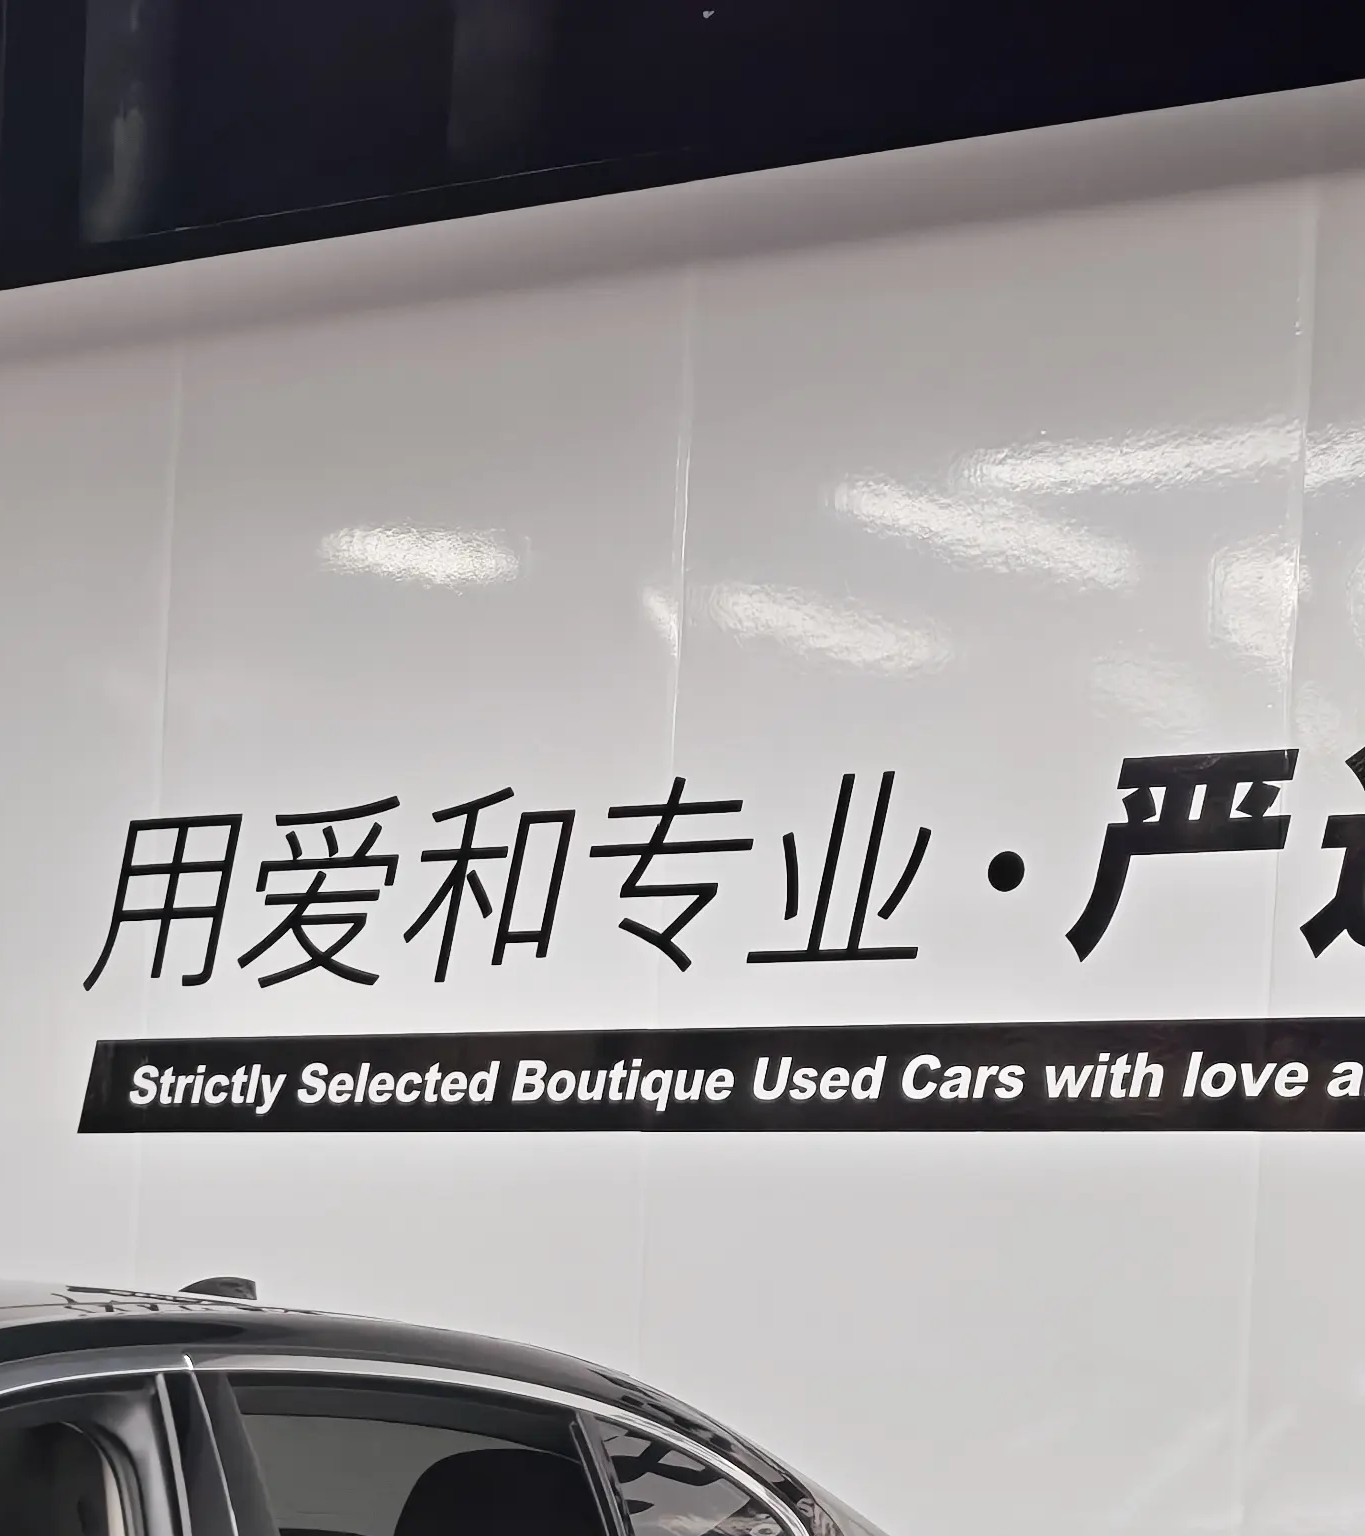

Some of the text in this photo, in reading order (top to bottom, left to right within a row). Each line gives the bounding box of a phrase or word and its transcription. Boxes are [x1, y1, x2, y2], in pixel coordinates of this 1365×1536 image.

[83, 746, 1365, 992] 用爱和专业·严
[130, 1051, 1365, 1114] Strictly Selected Boutique Used Cars with love a
